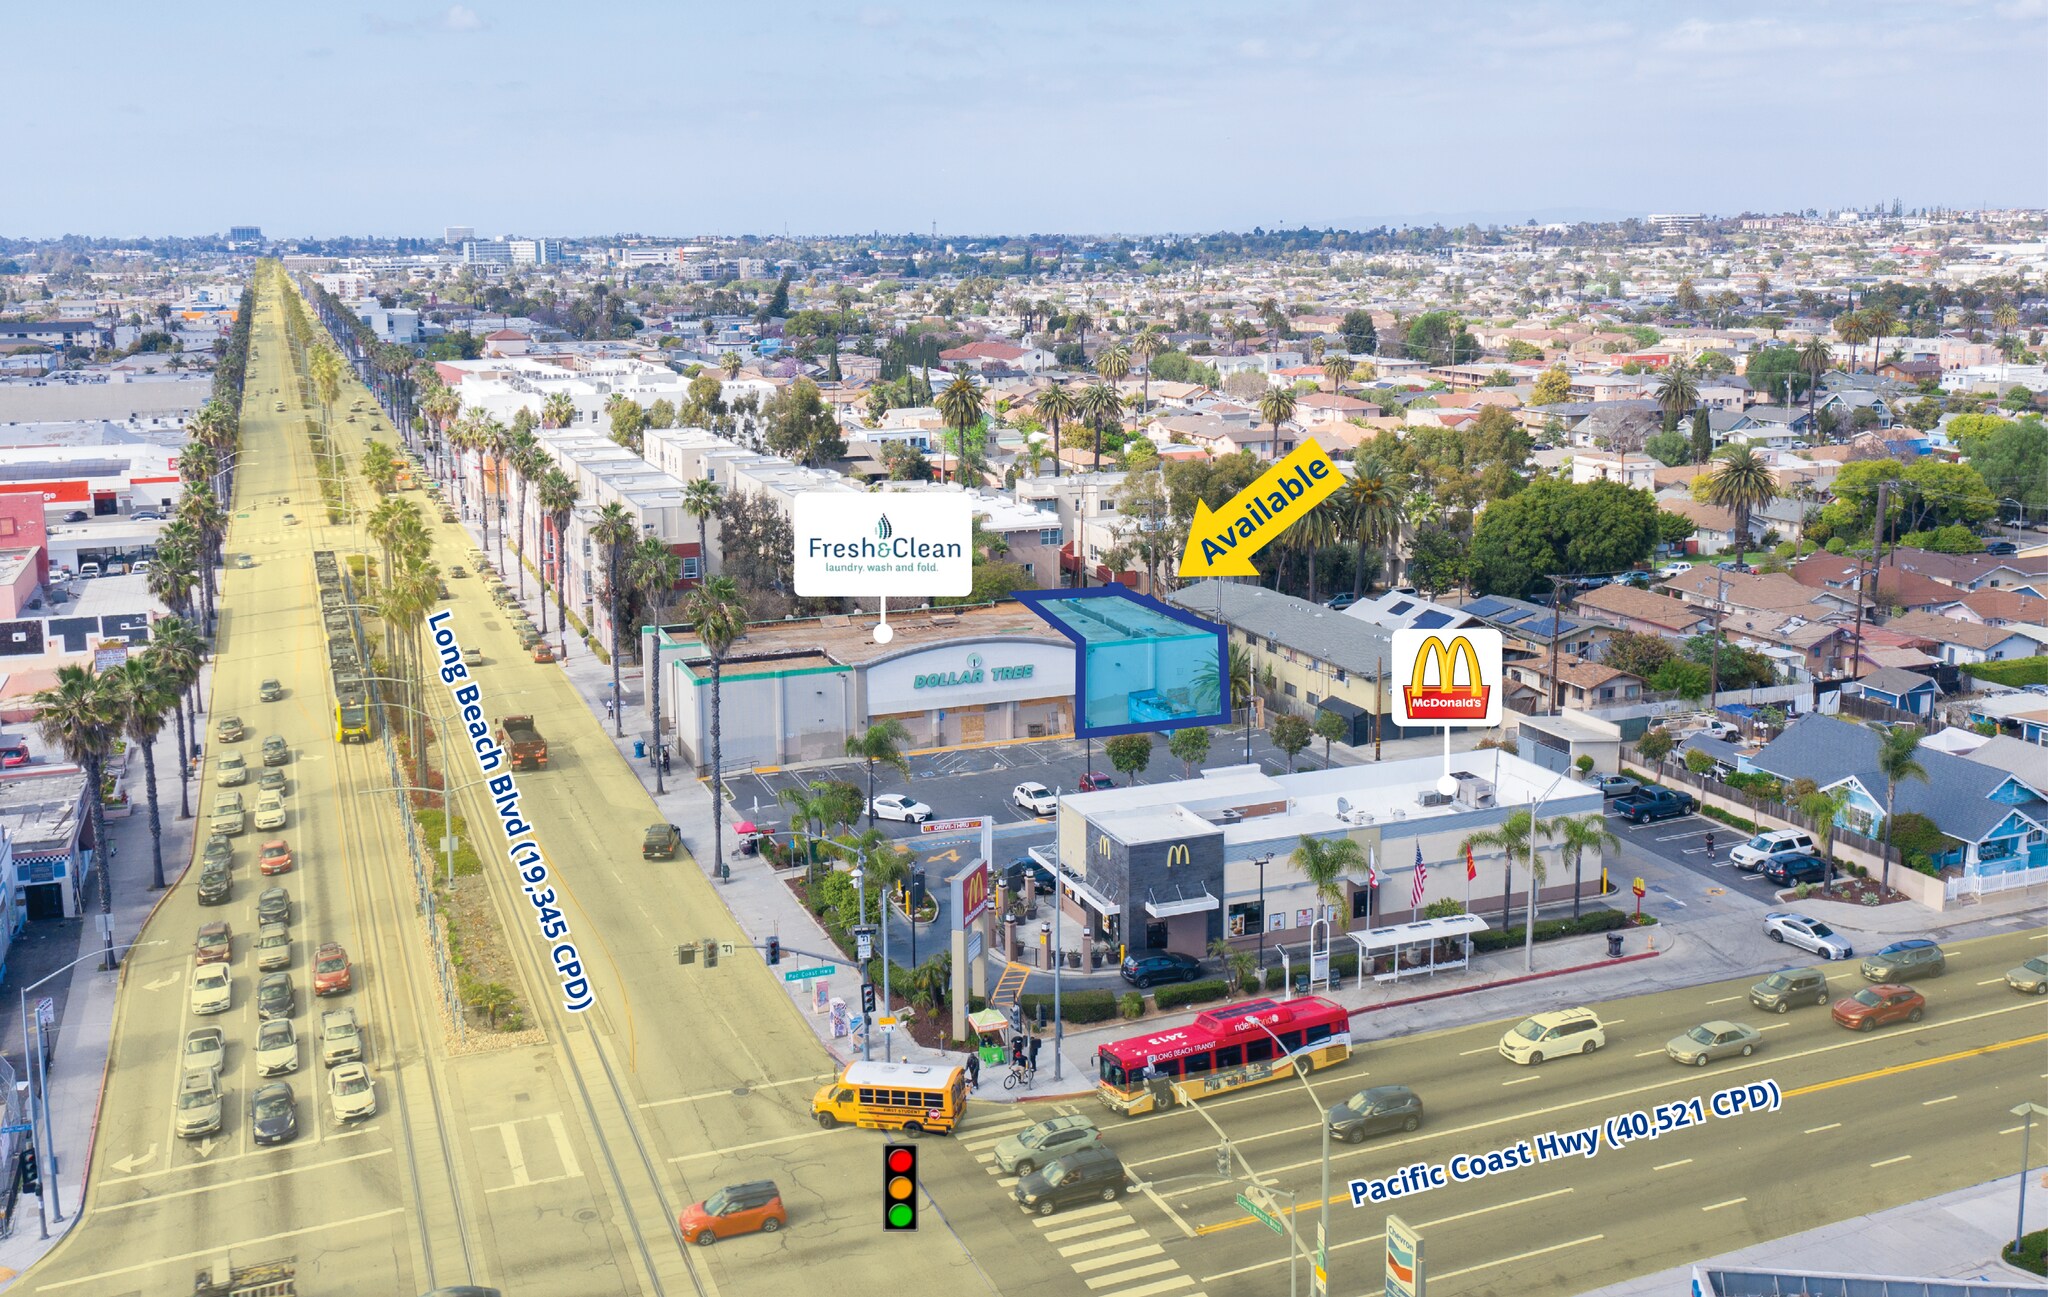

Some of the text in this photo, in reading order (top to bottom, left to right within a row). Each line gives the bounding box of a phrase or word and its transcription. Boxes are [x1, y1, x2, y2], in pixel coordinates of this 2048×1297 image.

[913, 664, 1034, 689] DOLLAR TREE
[1147, 1031, 1188, 1045] 2413
[1155, 1040, 1217, 1062] LONG BEACH TRANSIT
[1388, 1225, 1414, 1253] Chevron
